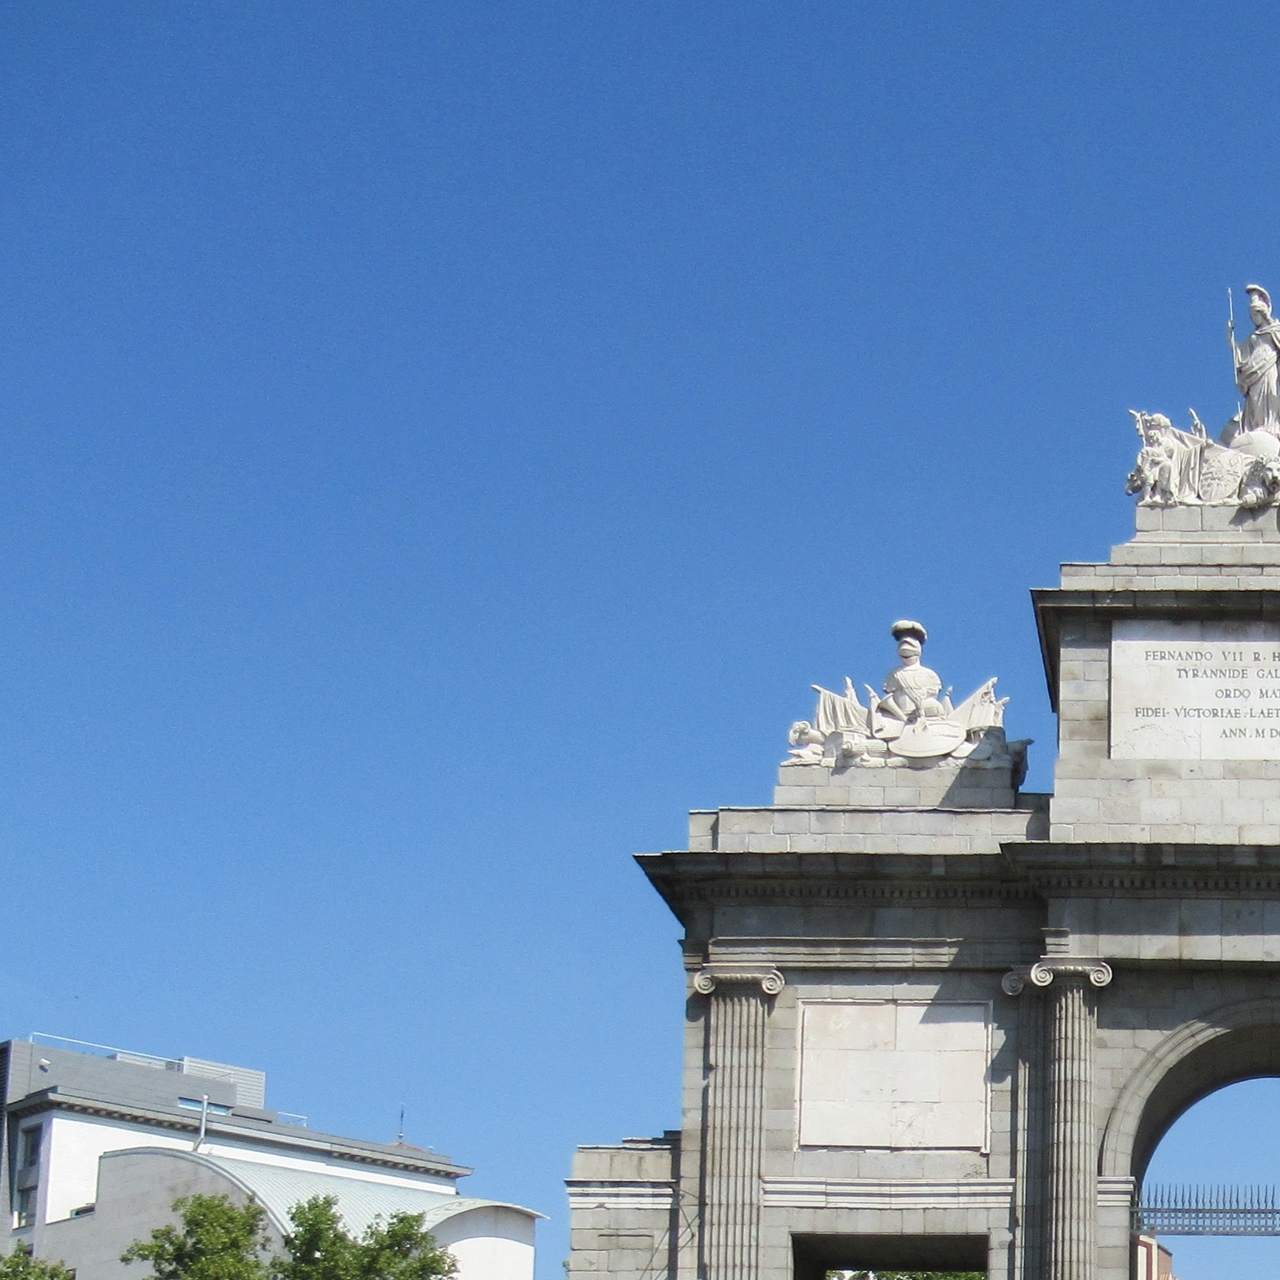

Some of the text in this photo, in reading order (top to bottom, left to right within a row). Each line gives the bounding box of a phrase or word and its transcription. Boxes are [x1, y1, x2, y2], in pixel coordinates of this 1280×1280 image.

[1144, 650, 1213, 661] FERNANDO
[1222, 651, 1243, 661] VII
[1176, 668, 1249, 679] TYRANNIDE
[1215, 688, 1251, 699] ORDO
